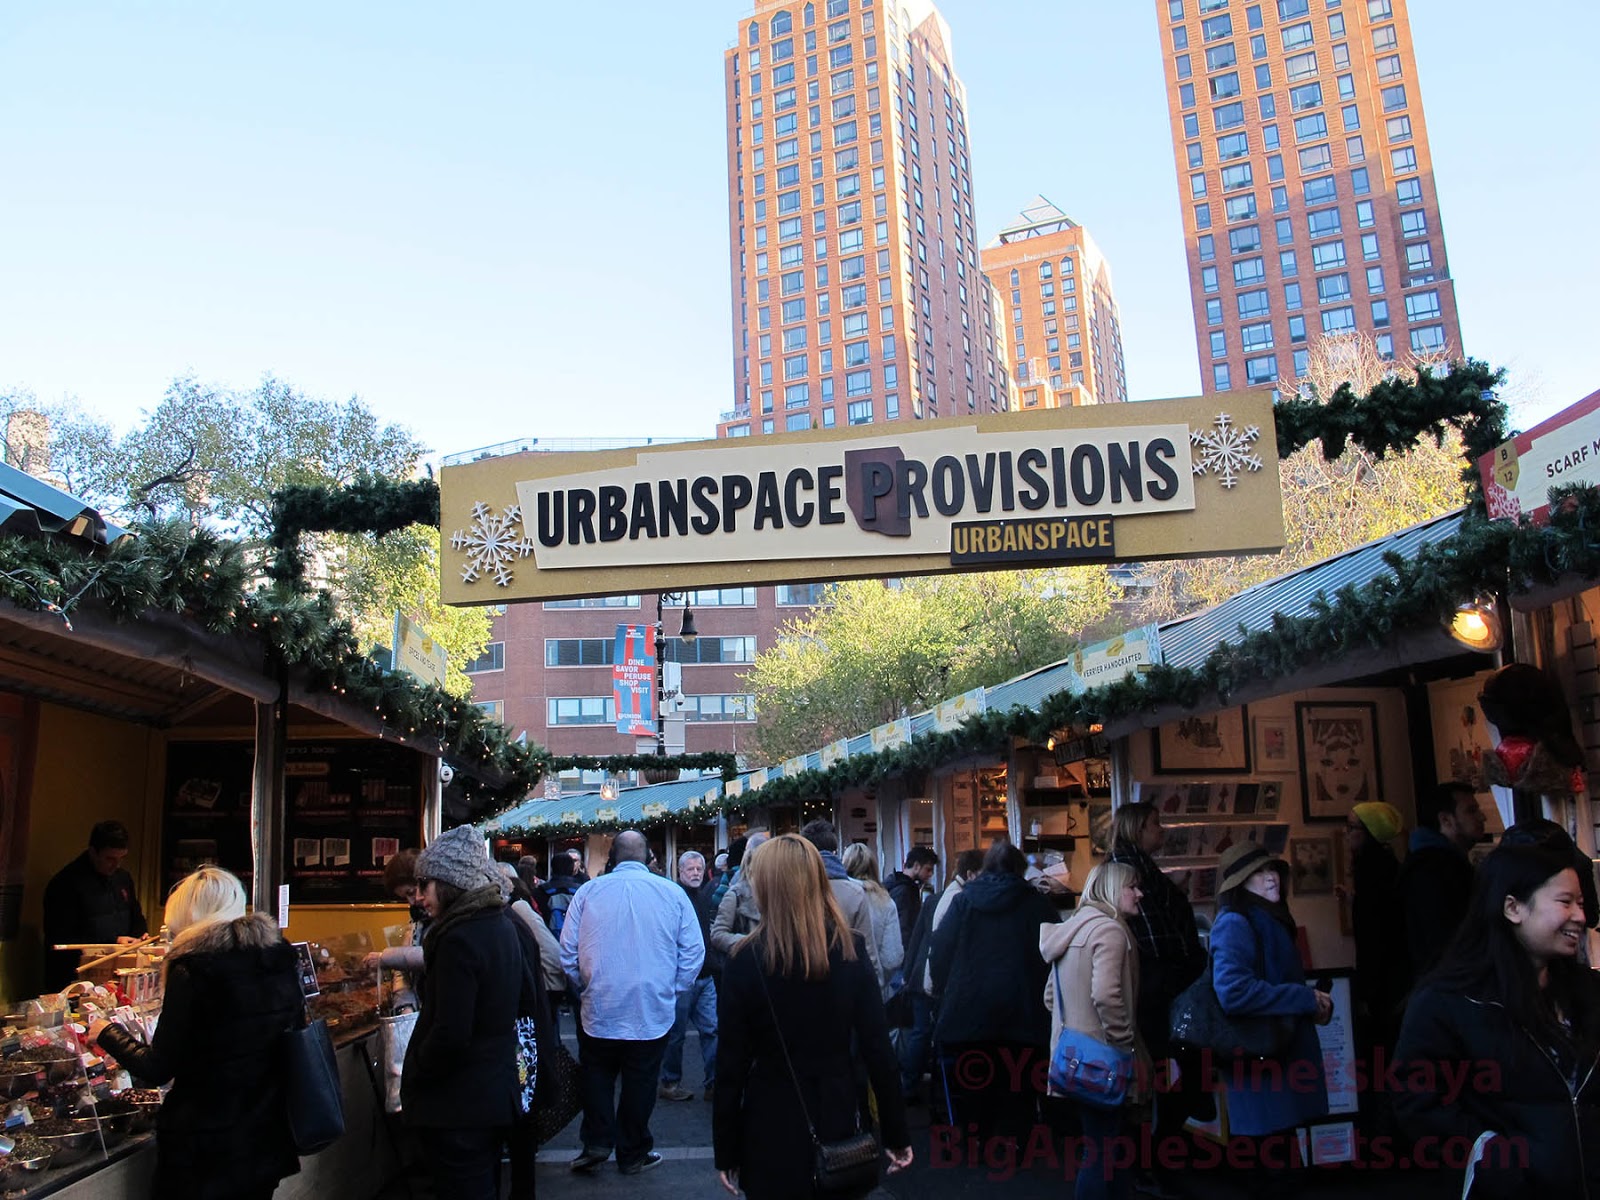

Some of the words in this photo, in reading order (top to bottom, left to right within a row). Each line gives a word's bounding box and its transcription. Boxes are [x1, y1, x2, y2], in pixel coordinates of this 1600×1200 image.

[1546, 445, 1589, 478] SCARF
[1504, 471, 1513, 482] 12
[536, 465, 846, 547] URBANSPACE
[860, 437, 1180, 521] PROVISIONS
[953, 519, 1112, 554] URBANSPACE
[628, 658, 645, 666] DINE
[1103, 652, 1142, 670] HANDCRAFTED
[615, 665, 639, 673] SAVOR
[624, 673, 652, 681] PERUSE
[619, 679, 639, 687] SHOP
[630, 686, 649, 694] VISIT
